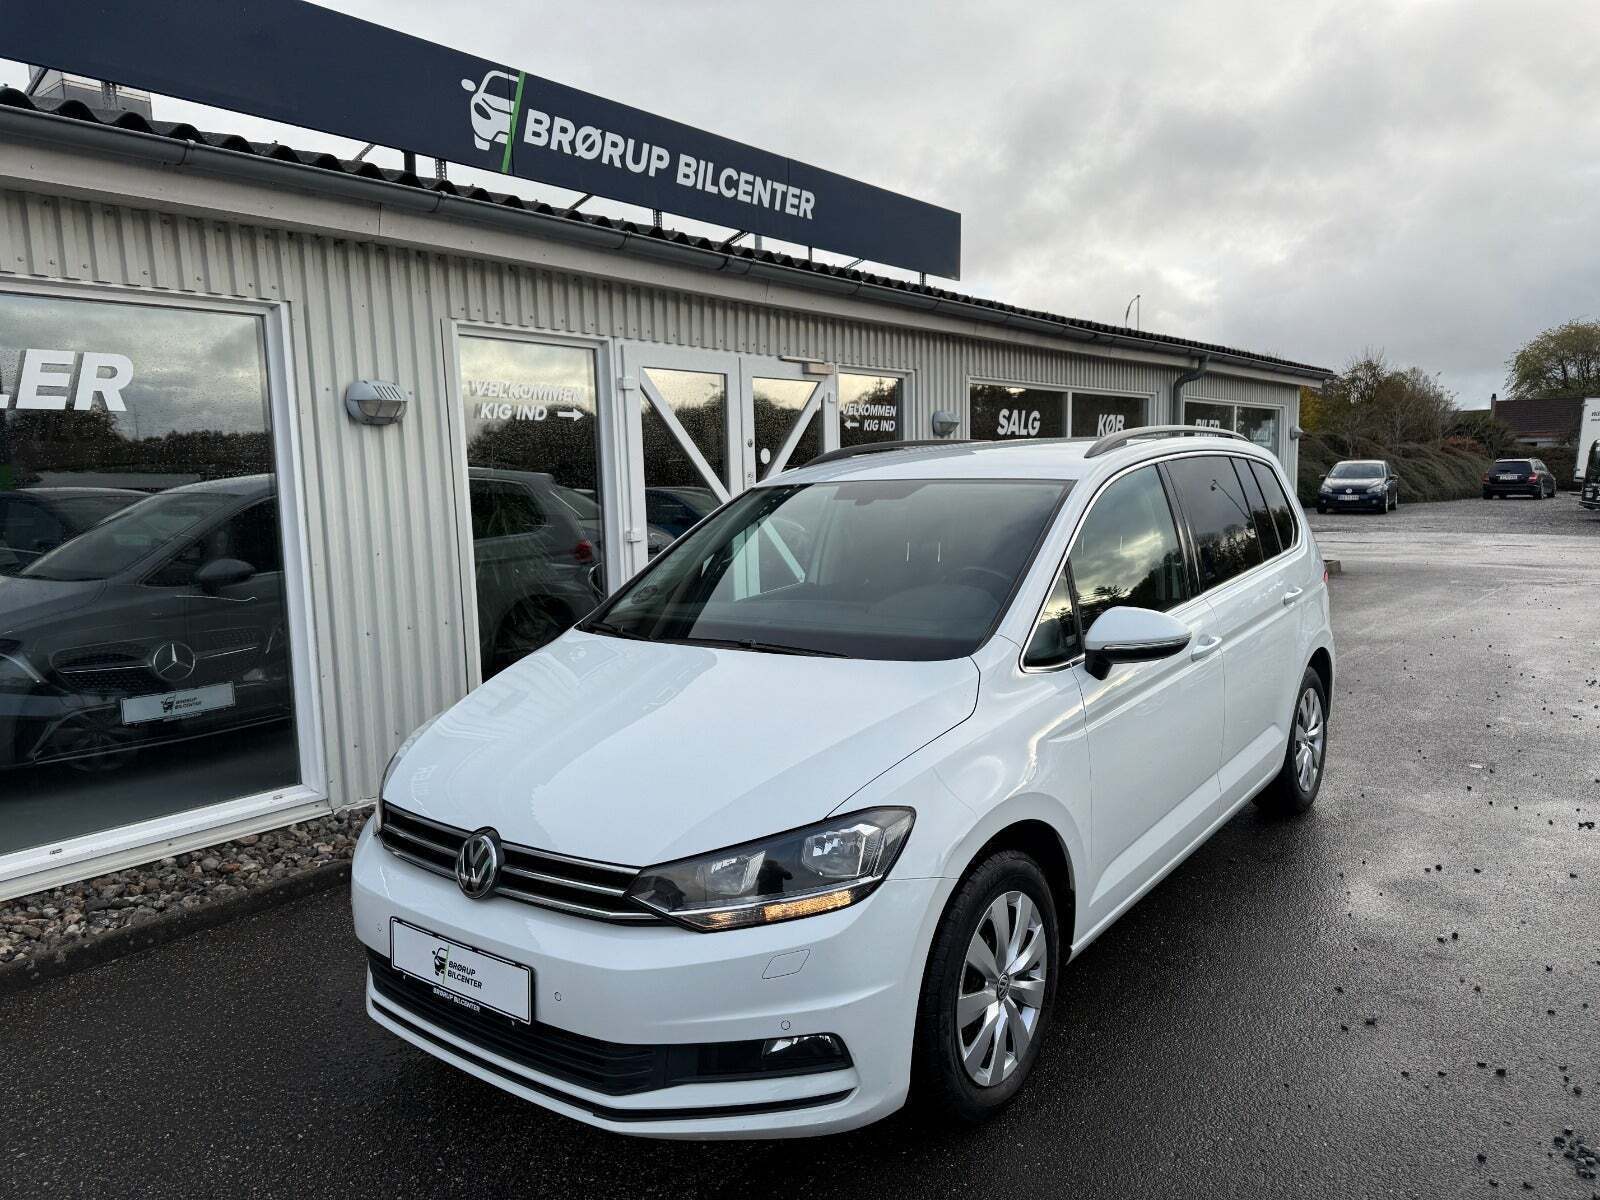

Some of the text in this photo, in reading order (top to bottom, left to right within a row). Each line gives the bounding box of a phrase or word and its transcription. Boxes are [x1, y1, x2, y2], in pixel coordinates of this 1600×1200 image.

[523, 108, 816, 220] BRØRUP BILCENTER
[0, 348, 134, 412] ER
[480, 403, 548, 421] KIG IND
[996, 408, 1040, 436] SALG
[863, 419, 896, 432] KIG IND
[1097, 414, 1125, 437] KØB
[447, 969, 483, 989] BILCENTER
[448, 960, 476, 977] BRØRUP
